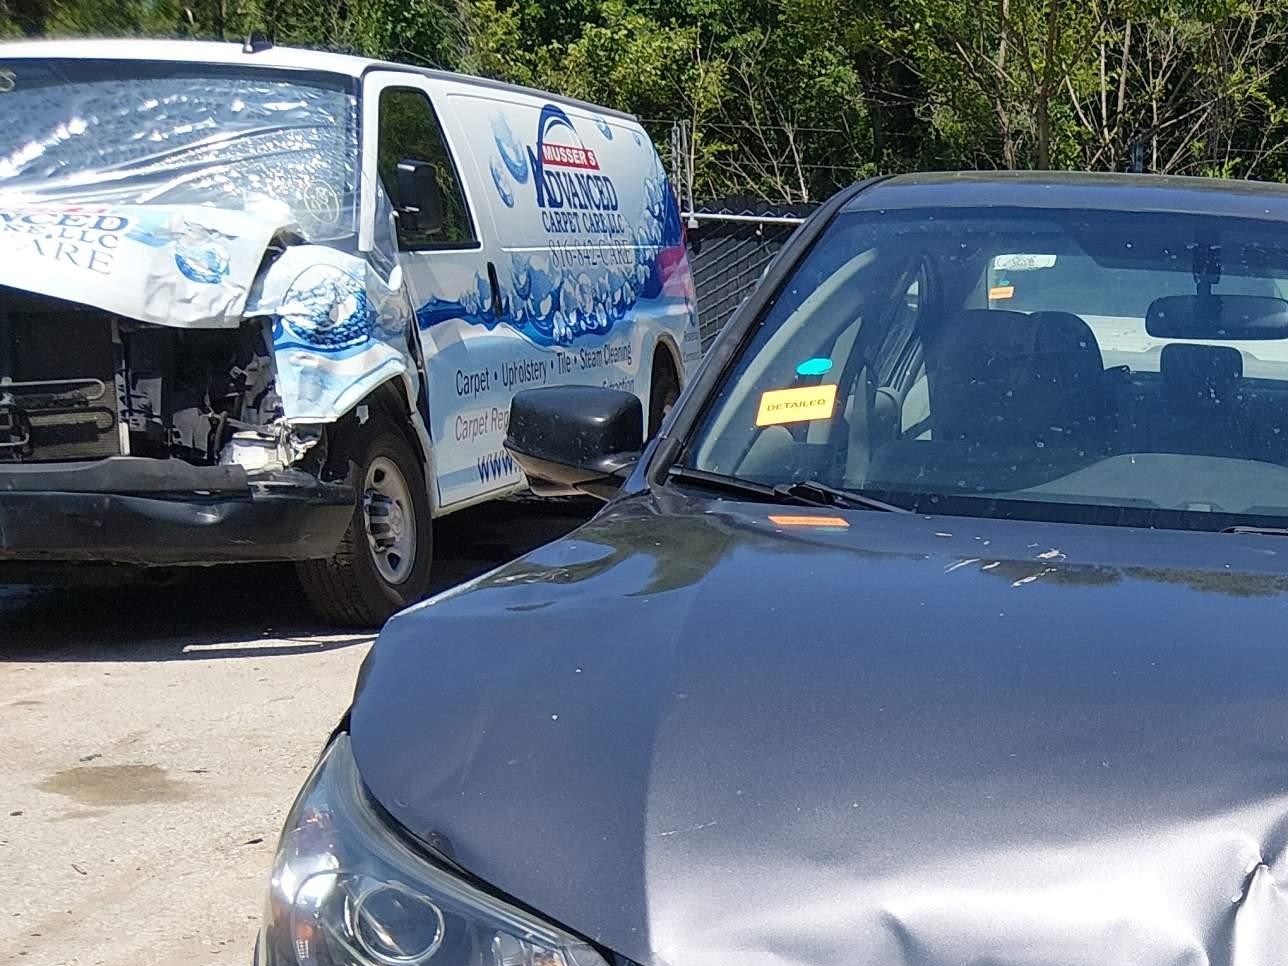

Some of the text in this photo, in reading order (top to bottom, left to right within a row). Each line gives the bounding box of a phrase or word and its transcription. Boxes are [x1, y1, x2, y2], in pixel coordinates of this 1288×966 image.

[542, 145, 596, 166] MUSSERS
[541, 211, 582, 234] CARPET
[608, 214, 625, 234] LLC
[548, 239, 633, 268] 816-842-CARE
[455, 342, 633, 400] Carpet Upholstery Tile Steam Cleaning
[767, 398, 826, 412] DETAILED
[455, 411, 488, 443] Carpet
[477, 450, 522, 484] www.
